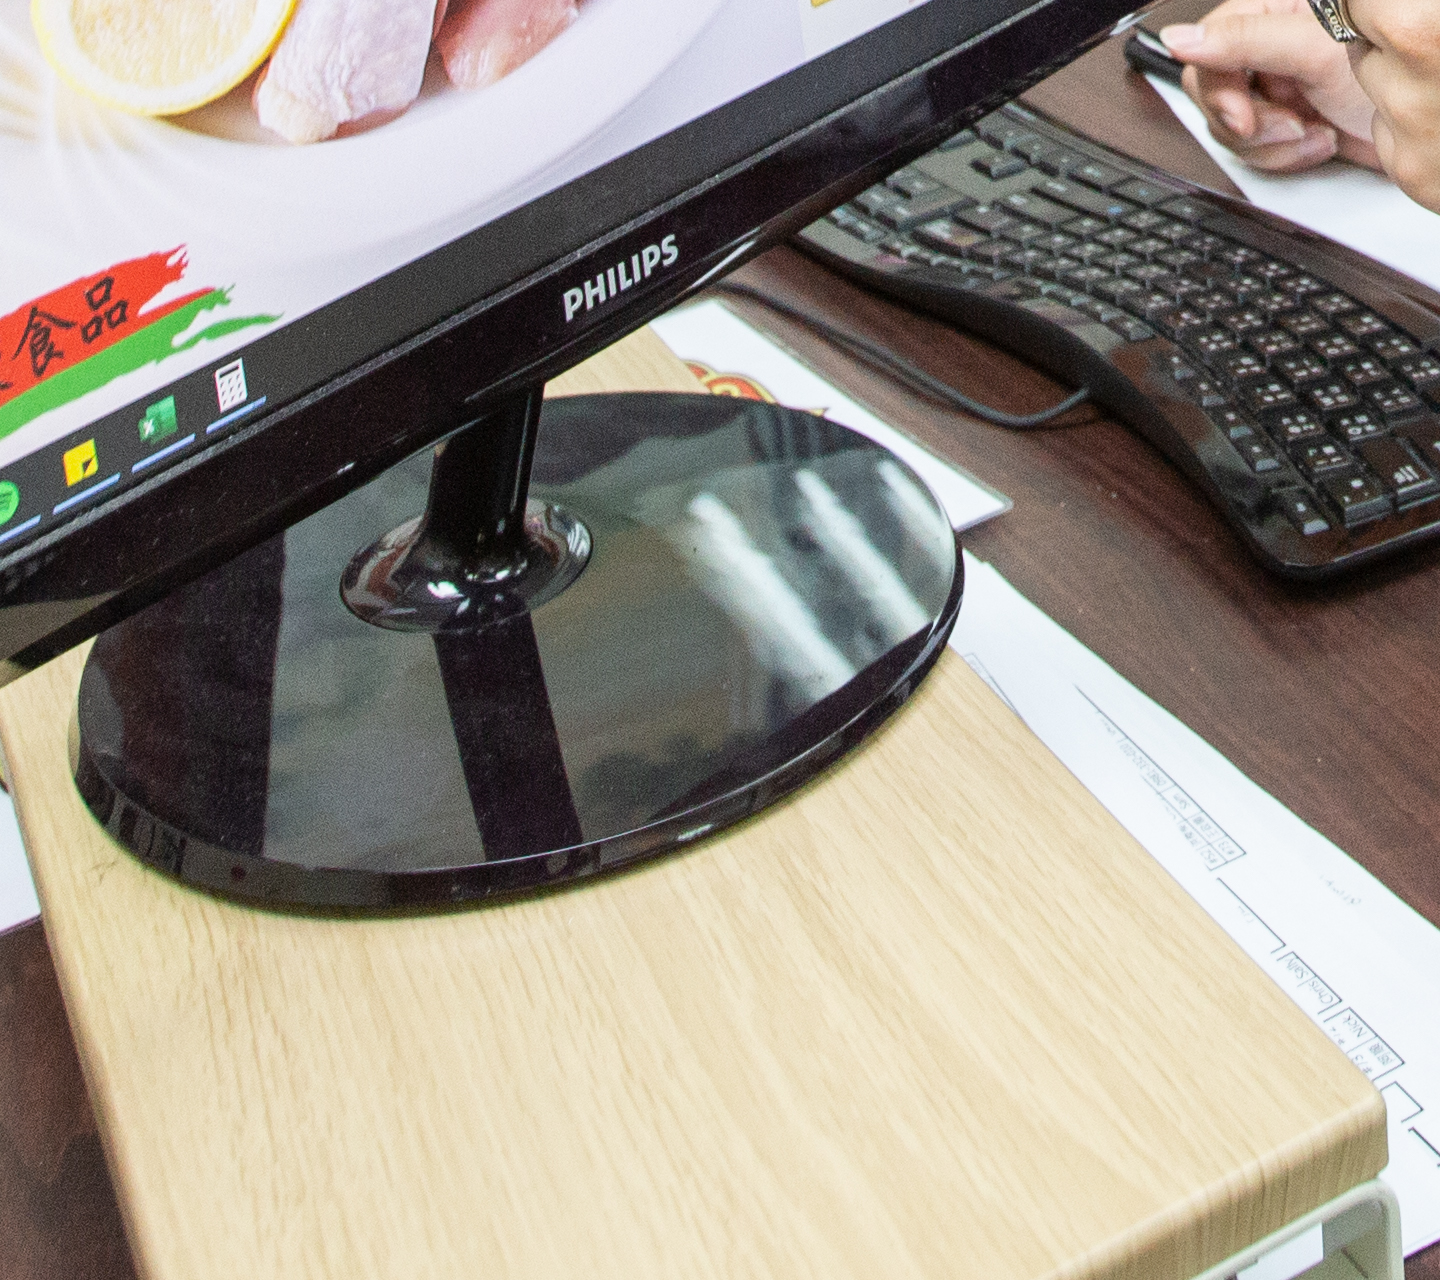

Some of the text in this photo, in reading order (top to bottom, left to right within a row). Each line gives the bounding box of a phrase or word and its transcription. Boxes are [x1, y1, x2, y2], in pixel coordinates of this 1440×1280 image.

[563, 234, 678, 322] PHILIPS
[1285, 956, 1334, 1005] Chris Sally
[1343, 1014, 1367, 1038] Nick
